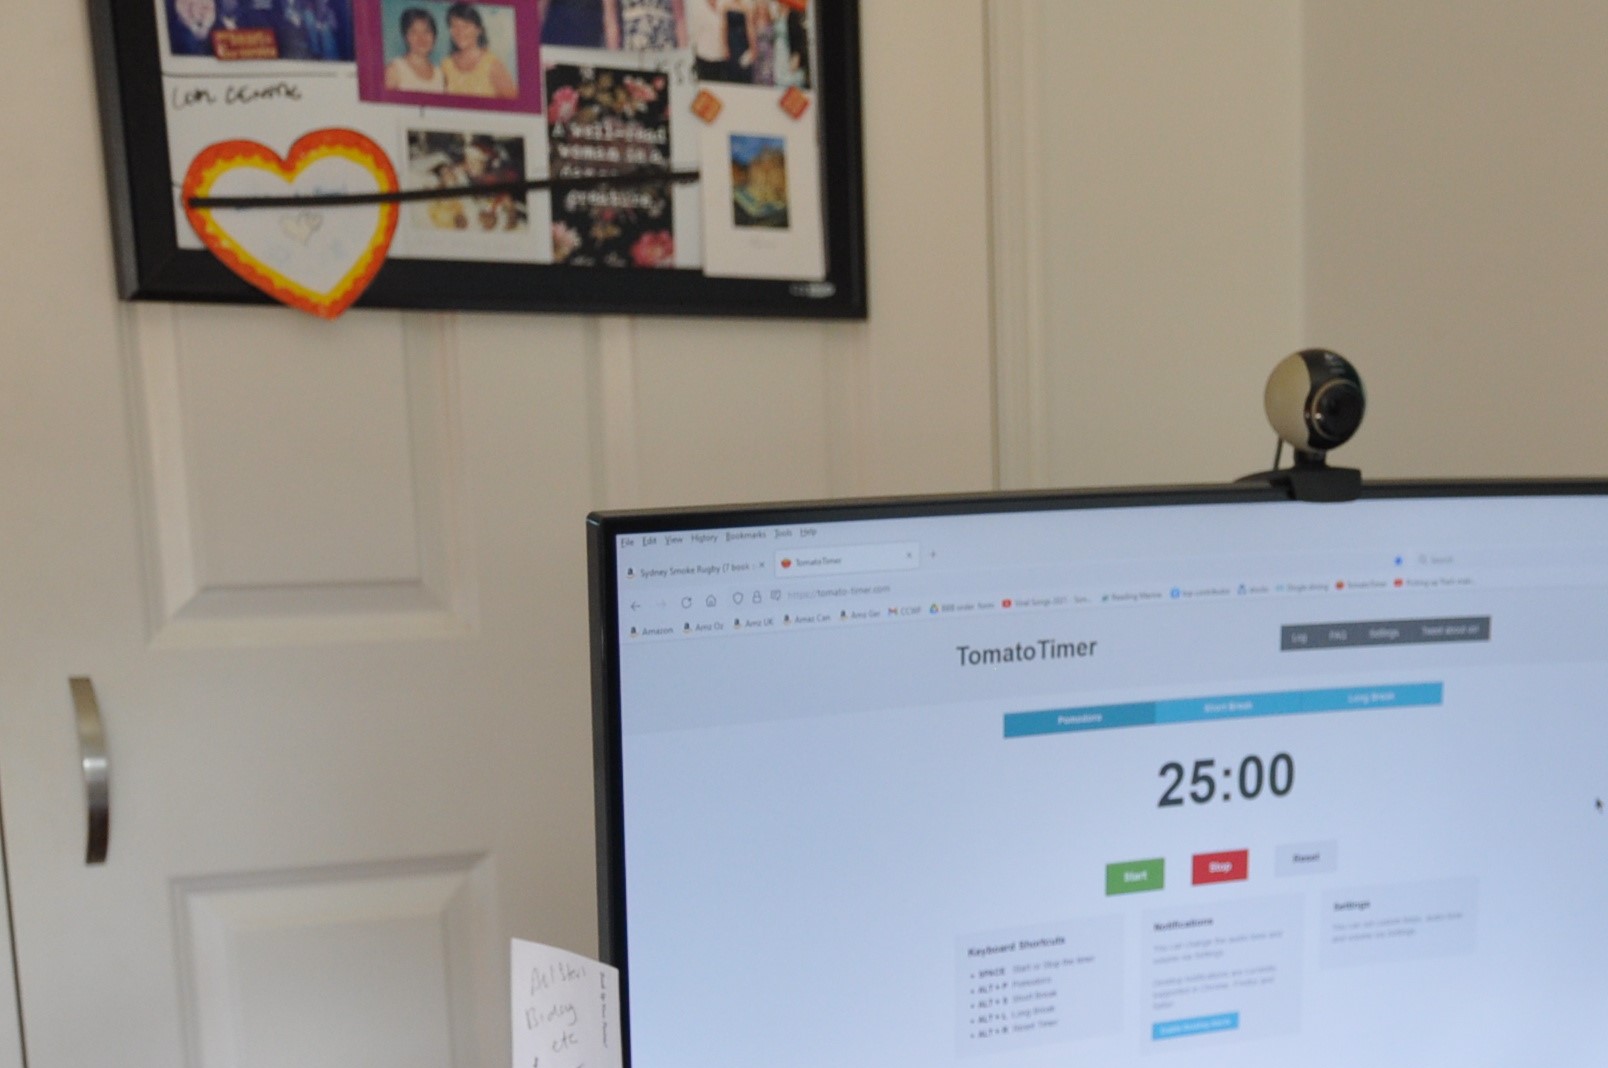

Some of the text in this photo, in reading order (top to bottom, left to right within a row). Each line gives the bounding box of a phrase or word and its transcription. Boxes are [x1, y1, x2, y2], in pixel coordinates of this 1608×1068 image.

[642, 537, 657, 547] Edit
[665, 535, 683, 546] View
[691, 533, 718, 544] History
[726, 531, 766, 542] Bookmarks
[641, 566, 668, 579] Sydney
[669, 565, 695, 576] Smoke
[697, 564, 721, 576] Rugby
[957, 639, 1097, 667] TomatoTimer
[1158, 752, 1295, 808] 25:00
[1124, 868, 1148, 883] Start
[1209, 860, 1232, 874] Stop
[968, 941, 1016, 958] Keyboard
